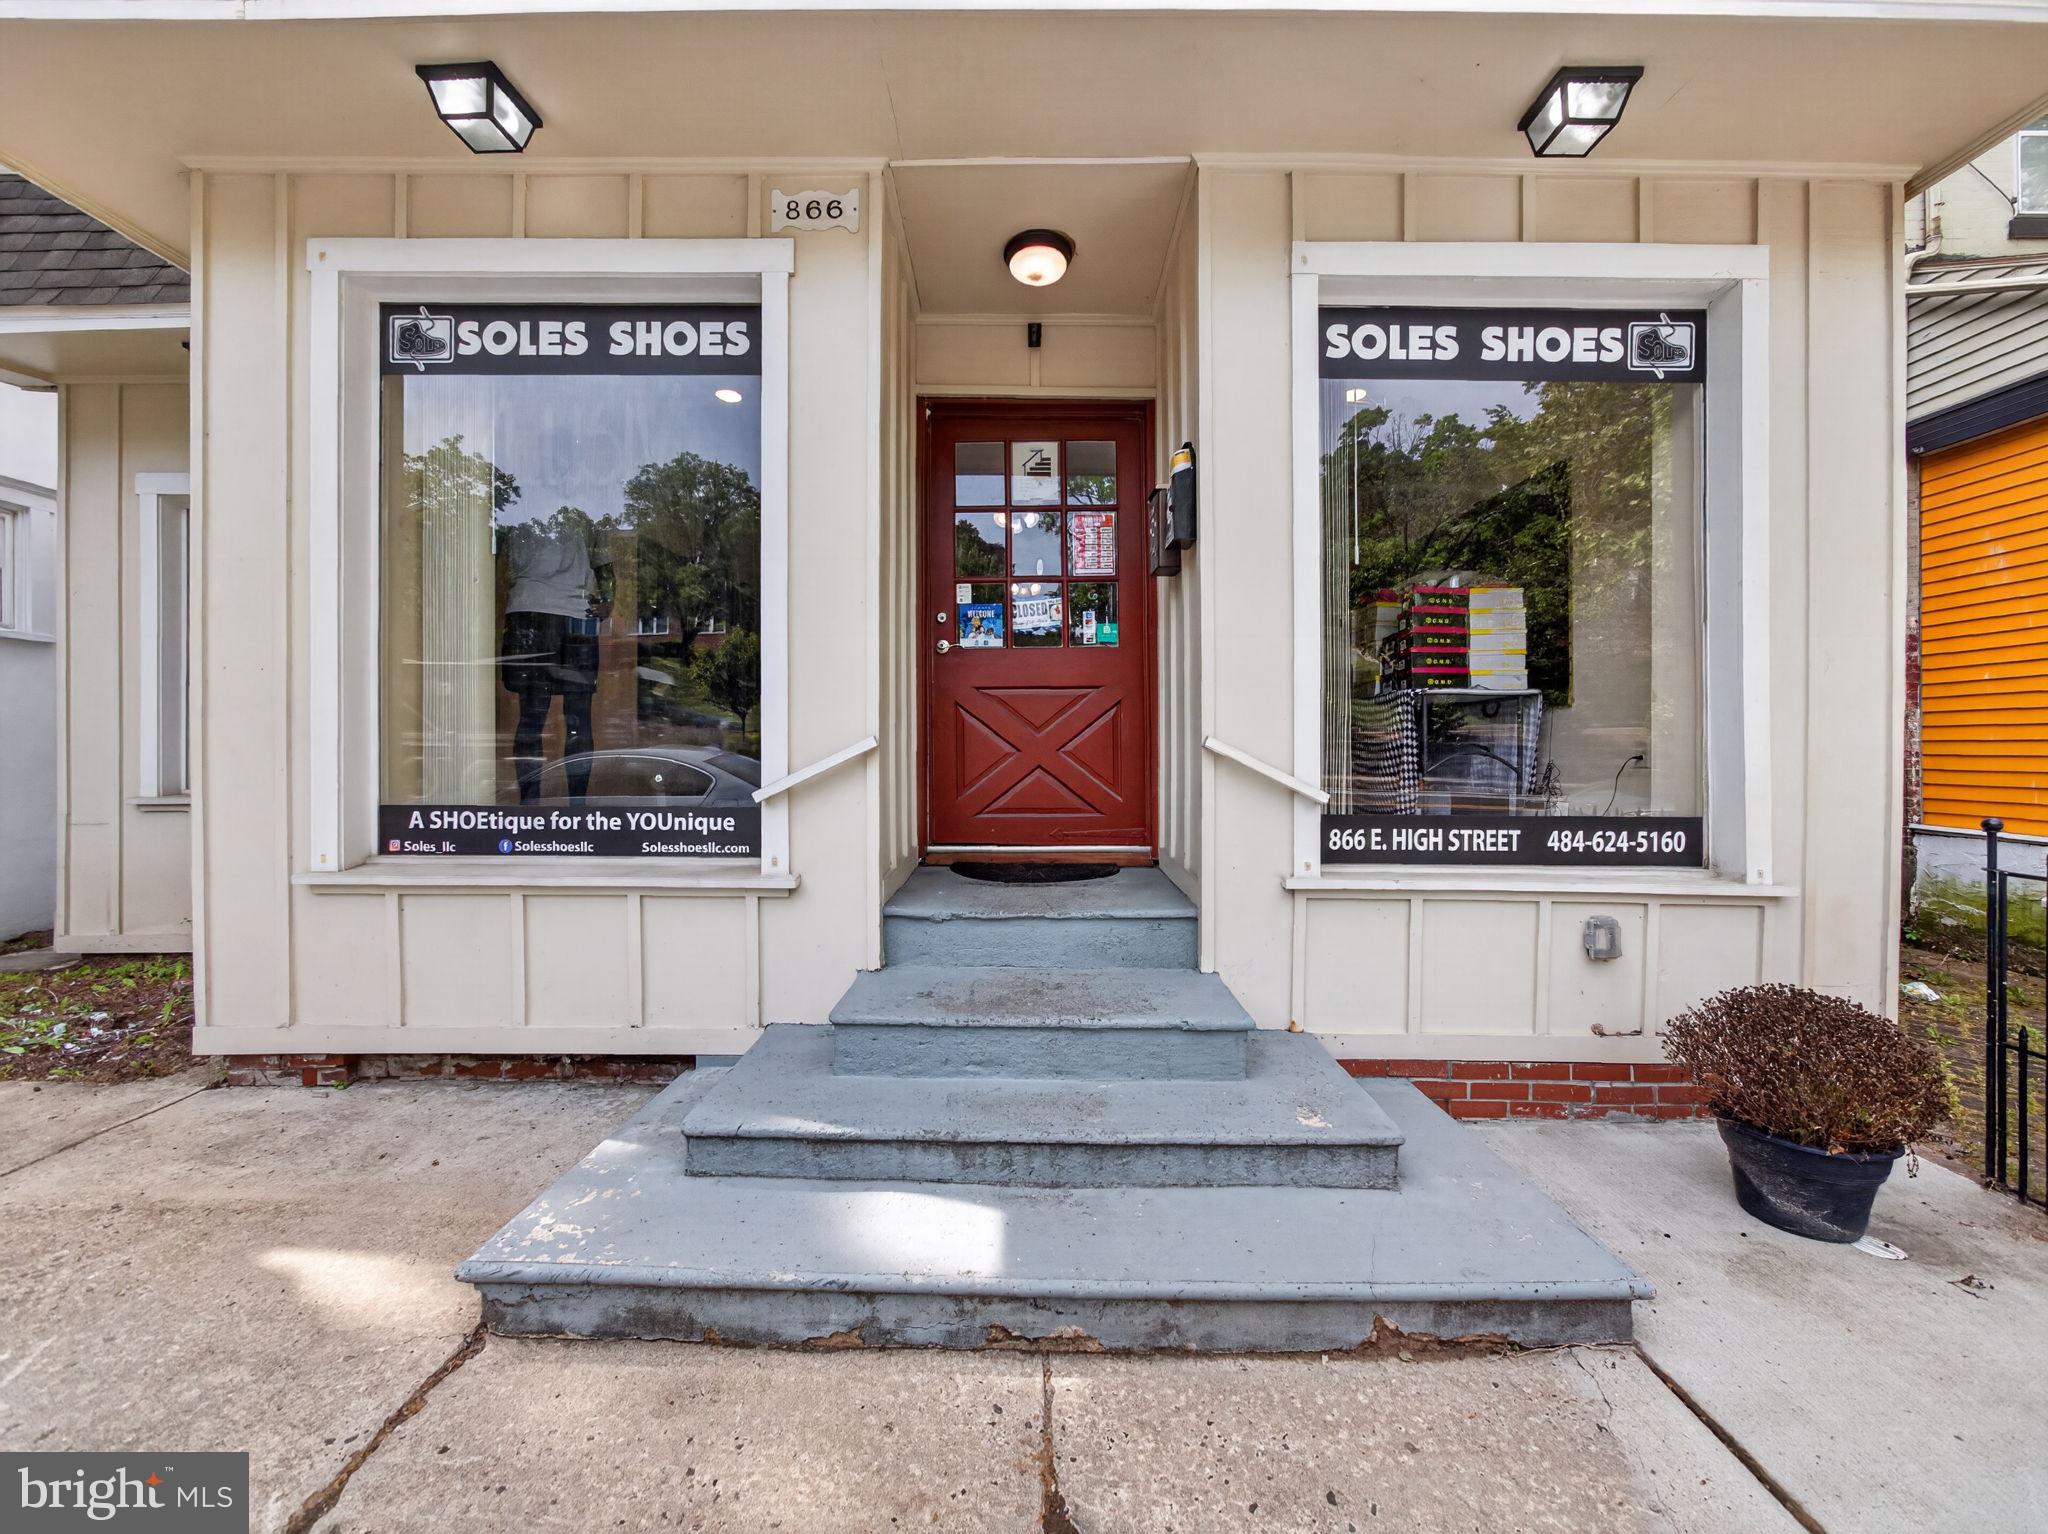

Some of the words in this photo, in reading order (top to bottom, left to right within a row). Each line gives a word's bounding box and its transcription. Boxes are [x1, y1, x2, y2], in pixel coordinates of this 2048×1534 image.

[785, 199, 843, 220] 866
[457, 320, 589, 356] SOLES
[608, 320, 751, 357] SHOES
[1325, 323, 1460, 361] SOLES
[1480, 326, 1625, 363] SHOES
[1012, 602, 1048, 619] CLOSED
[408, 810, 425, 829] A
[429, 810, 546, 835] SHOEtique
[550, 810, 582, 830] for
[585, 811, 622, 831] the
[626, 812, 736, 835] YOUnique
[514, 840, 594, 854] Solesshoesllc
[641, 841, 750, 854] Solesshoesllc.com
[1328, 828, 1366, 851] 866
[1370, 828, 1387, 851] E.
[1392, 828, 1443, 851] HIGH
[1447, 829, 1522, 852] STREET
[1547, 830, 1686, 853] 484-624-5160
